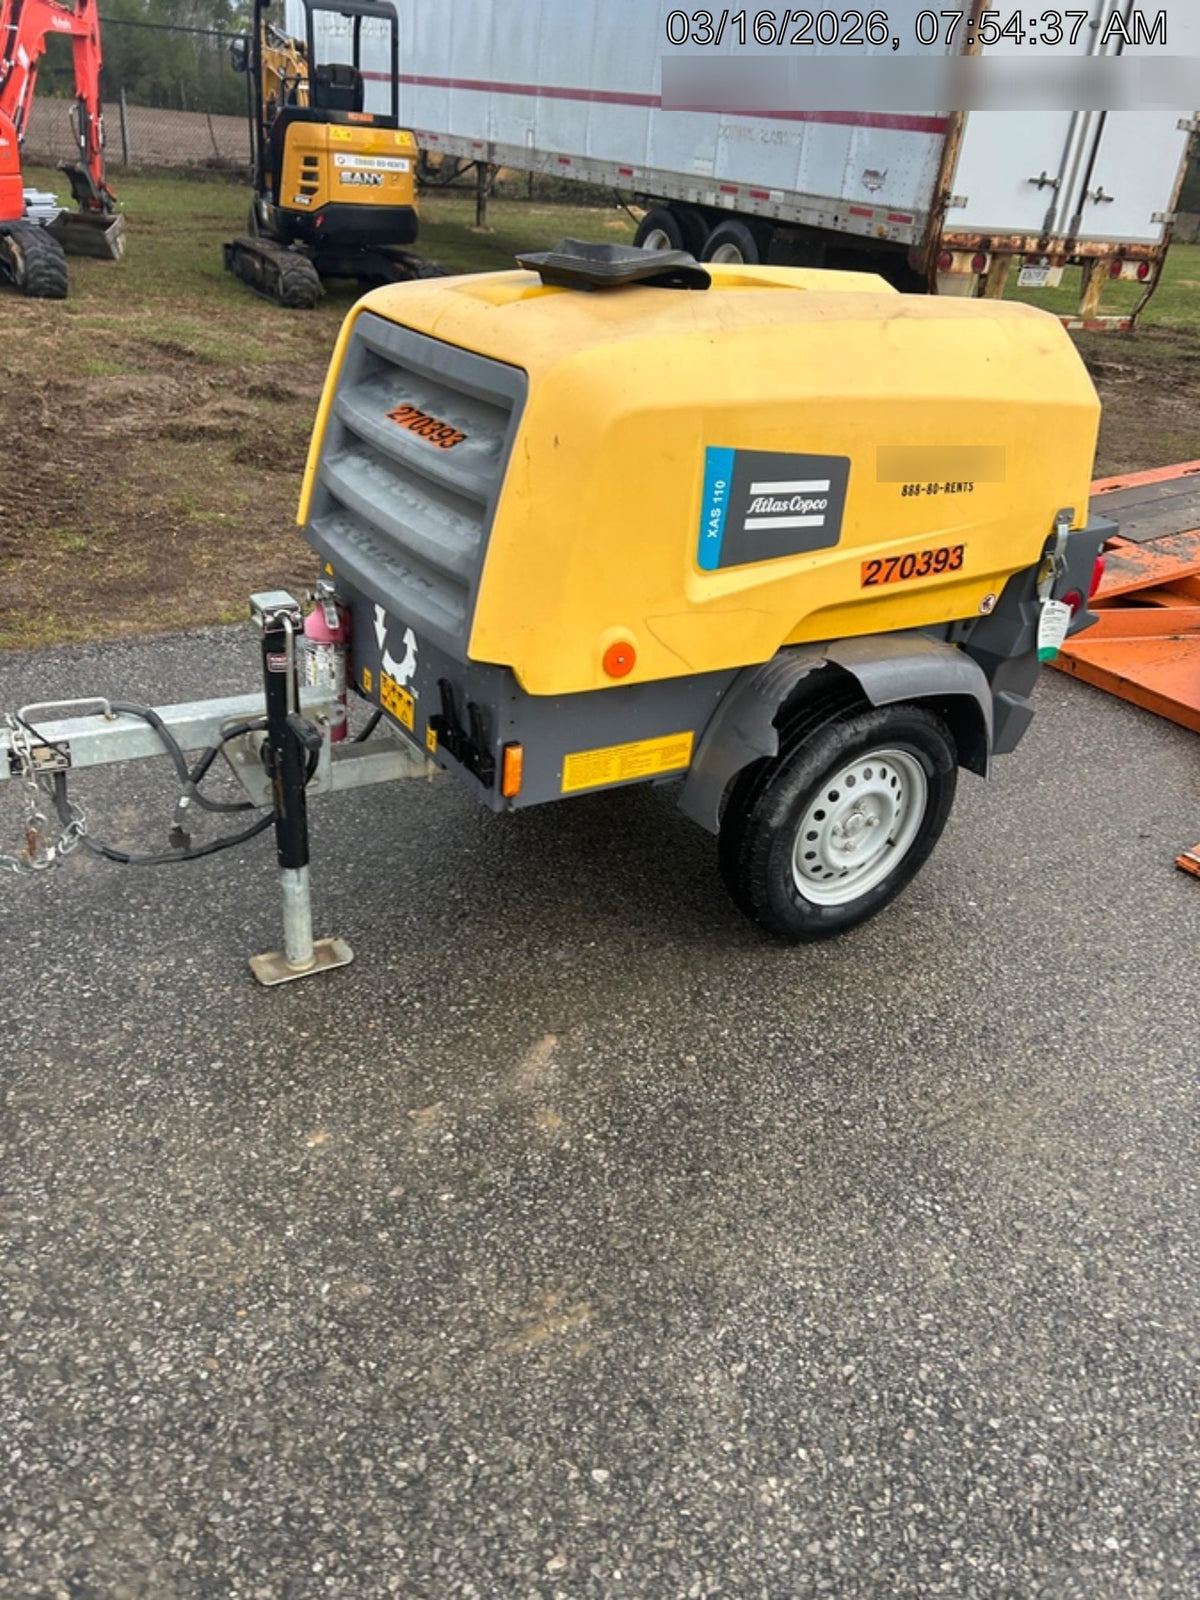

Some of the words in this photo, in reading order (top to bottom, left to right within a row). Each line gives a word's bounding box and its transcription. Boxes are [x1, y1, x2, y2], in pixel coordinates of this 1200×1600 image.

[340, 171, 384, 187] SANY
[385, 406, 468, 449] 270393
[712, 480, 727, 504] 110
[901, 482, 974, 497] 888-80-RENTS
[746, 497, 788, 514] Atlas
[789, 495, 828, 514] Copco
[707, 507, 722, 538] XAS
[862, 544, 965, 588] 270393
